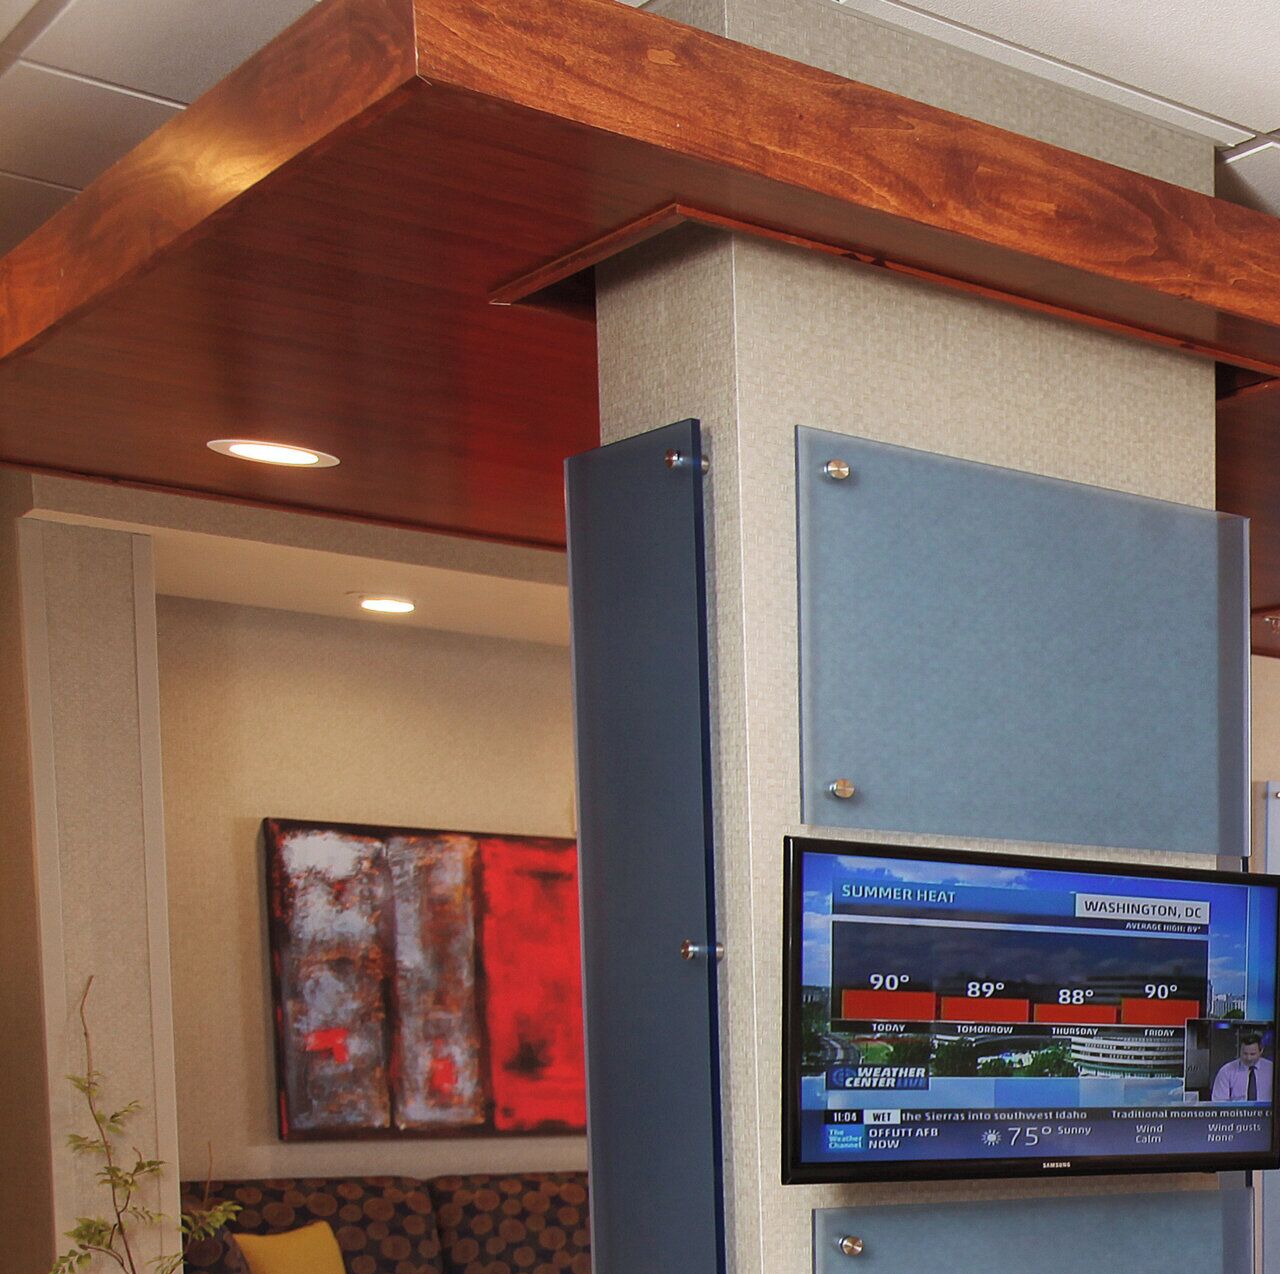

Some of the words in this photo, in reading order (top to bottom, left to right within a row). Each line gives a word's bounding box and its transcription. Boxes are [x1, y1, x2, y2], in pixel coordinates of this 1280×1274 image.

[842, 884, 912, 901] SUMMER
[917, 889, 956, 904] HEAT
[1084, 899, 1182, 919] WASHINGTON,
[1185, 906, 1202, 919] DC
[1125, 922, 1162, 932] AVERAGE
[872, 1023, 906, 1032] TODAY
[957, 1025, 1014, 1034] TOMORROW
[1051, 1027, 1099, 1037] THURSDAY
[1144, 1029, 1175, 1037] FRIDAY
[857, 1067, 926, 1078] WEATHER
[845, 1077, 896, 1088] CENTER
[833, 1111, 857, 1122] 11:04
[872, 1112, 891, 1122] WET
[902, 1111, 921, 1122] the
[925, 1111, 965, 1121] Sierras
[968, 1110, 991, 1121] into
[994, 1110, 1052, 1121] southwest
[1055, 1110, 1087, 1120] Idaho
[1112, 1109, 1168, 1119] Traditional
[1170, 1110, 1217, 1118] monsoon
[1220, 1109, 1263, 1118] moisture
[868, 1128, 912, 1138] OFFUTT
[916, 1127, 938, 1137] AFB
[1057, 1125, 1092, 1136] Sunny
[1136, 1124, 1164, 1133] Wind
[1208, 1123, 1234, 1132] Wind
[1236, 1123, 1261, 1133] gusts
[1136, 1134, 1162, 1143] Calm
[1207, 1133, 1234, 1142] None
[829, 1141, 862, 1149] Channel
[868, 1140, 900, 1149] NOW
